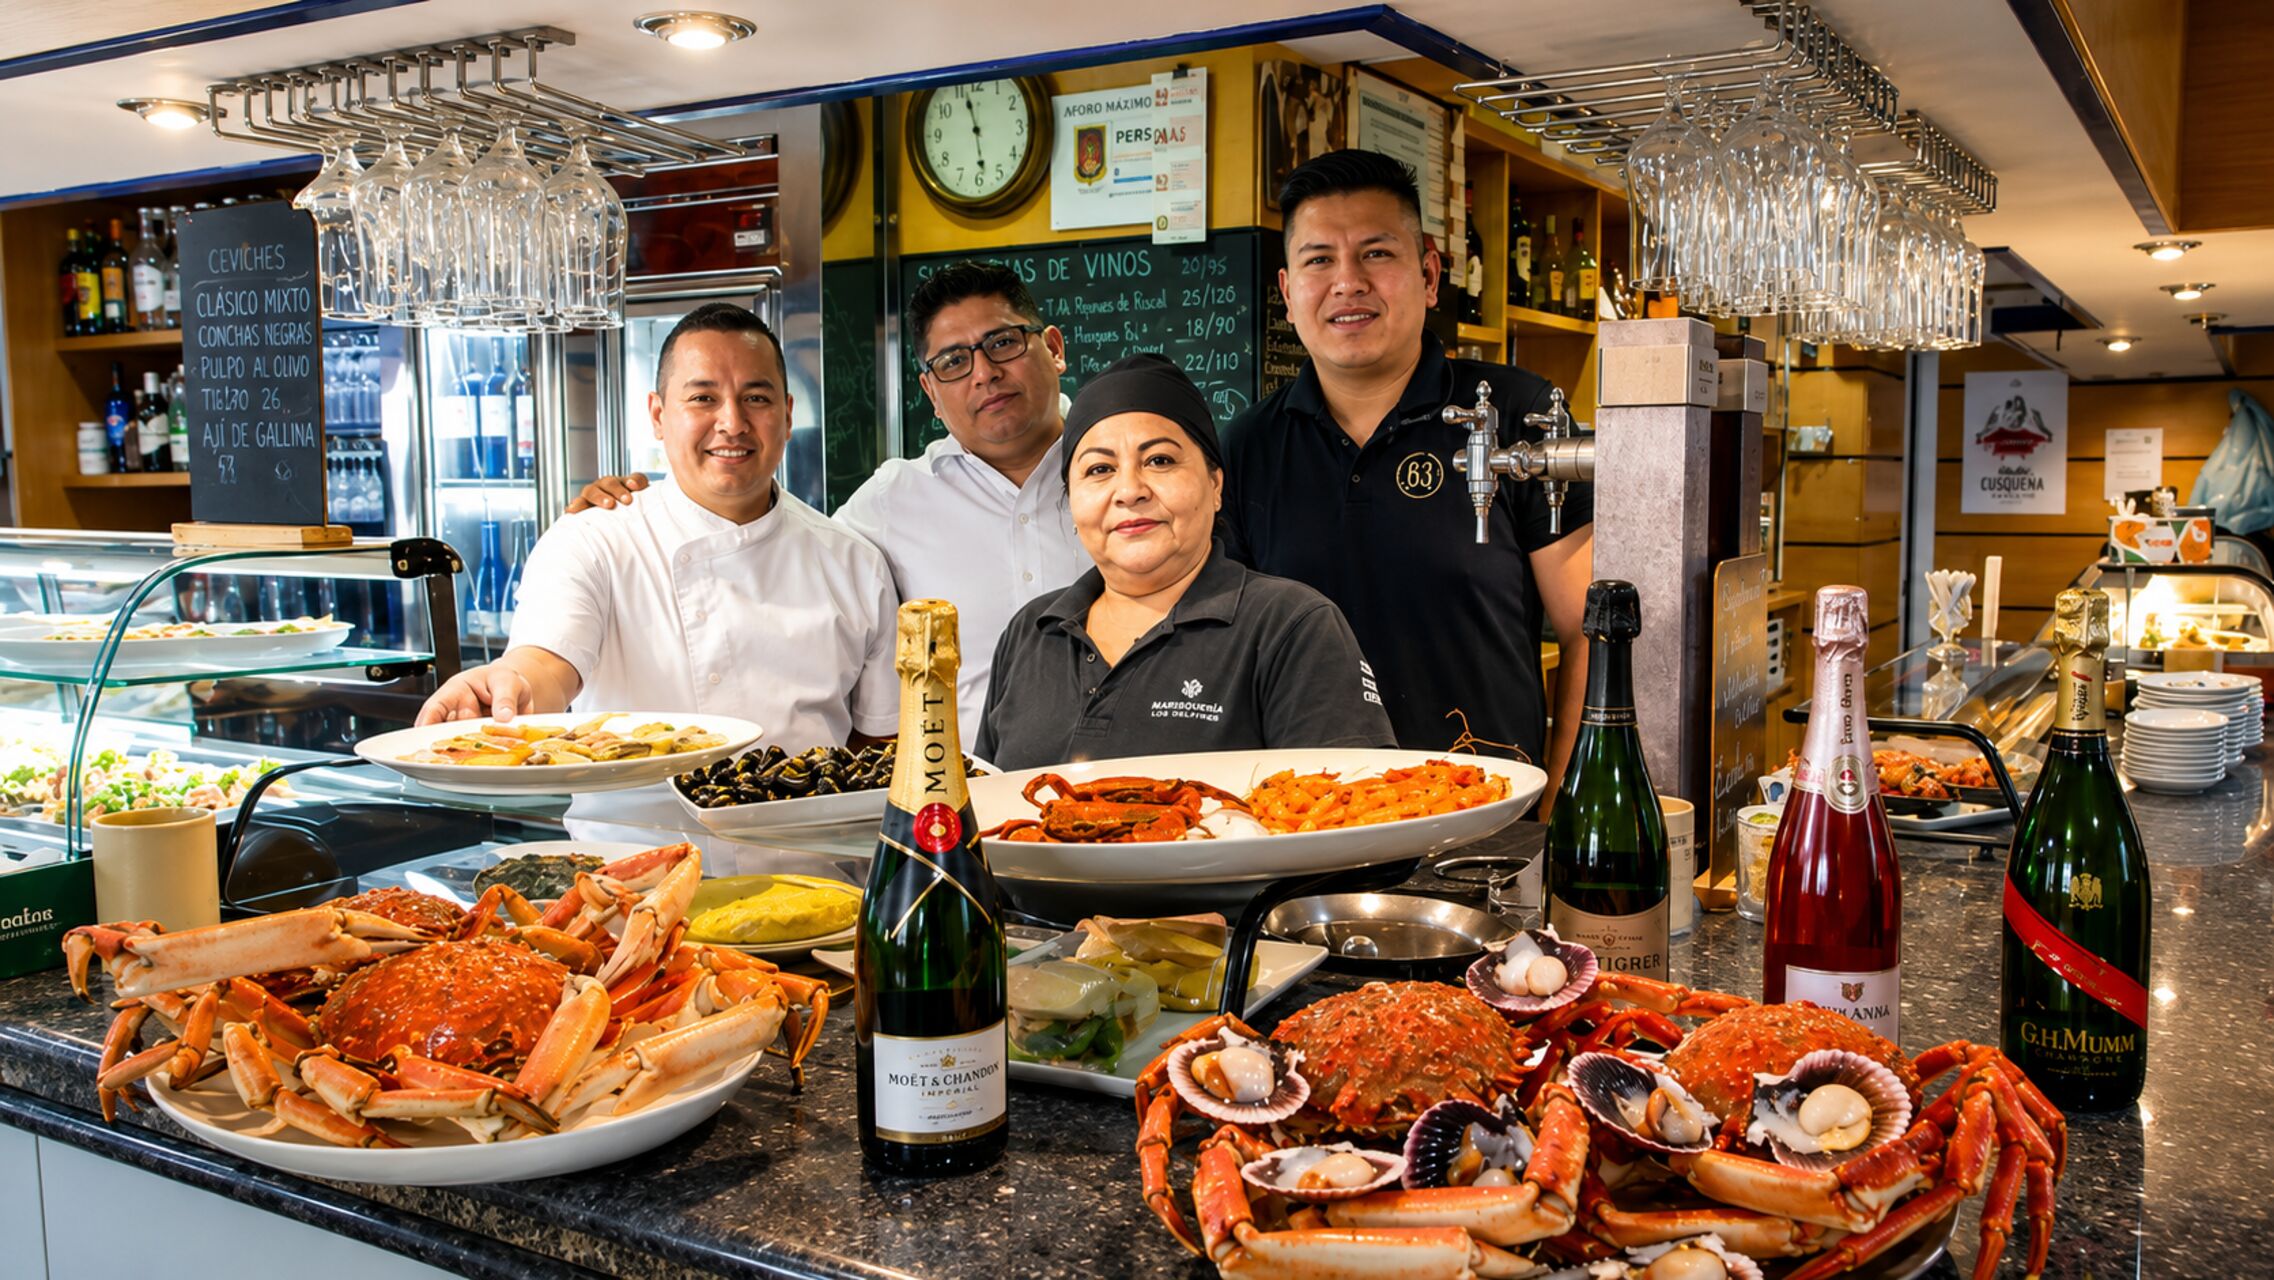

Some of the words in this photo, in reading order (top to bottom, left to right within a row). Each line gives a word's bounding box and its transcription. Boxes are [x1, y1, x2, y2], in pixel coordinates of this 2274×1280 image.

[939, 102, 952, 119] 10
[1008, 95, 1016, 111] 2
[1064, 101, 1102, 118] AFORO
[934, 128, 942, 143] 9
[1016, 119, 1024, 136] 3
[941, 151, 950, 167] 8
[1009, 145, 1017, 160] 4
[956, 167, 964, 181] 7
[974, 168, 984, 187] 6
[995, 164, 1004, 181] 5
[208, 244, 285, 274] CEVICHES
[1048, 258, 1070, 281] DE
[1084, 250, 1151, 279] VINOS
[196, 286, 258, 318] CLÁSICO
[264, 287, 310, 313] MIXTO
[198, 324, 260, 348] CONCHAS
[264, 321, 313, 345] NEGRAS
[201, 356, 245, 379] PULPO
[253, 357, 270, 378] AL
[262, 387, 281, 410] 26
[232, 423, 250, 448] DE
[256, 421, 316, 448] GALLINA
[1407, 461, 1432, 487] 63
[1851, 1004, 1890, 1020] ANNA
[931, 1076, 940, 1087] &
